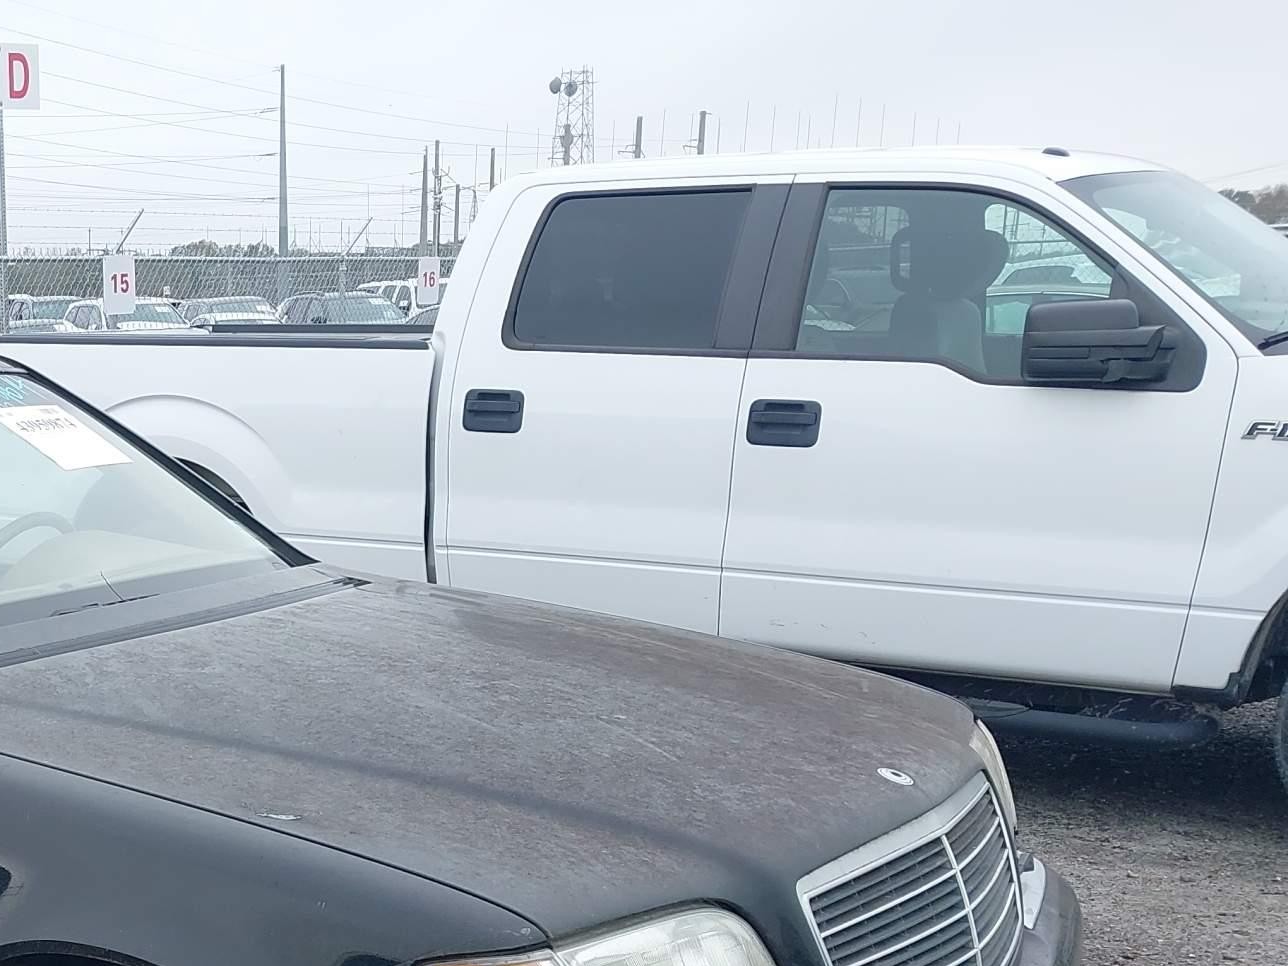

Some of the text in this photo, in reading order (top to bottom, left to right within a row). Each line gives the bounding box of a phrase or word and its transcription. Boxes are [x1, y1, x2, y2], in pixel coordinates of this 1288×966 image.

[7, 51, 30, 101] D
[110, 271, 130, 295] 15
[422, 270, 436, 288] 16
[1241, 420, 1288, 441] F-1
